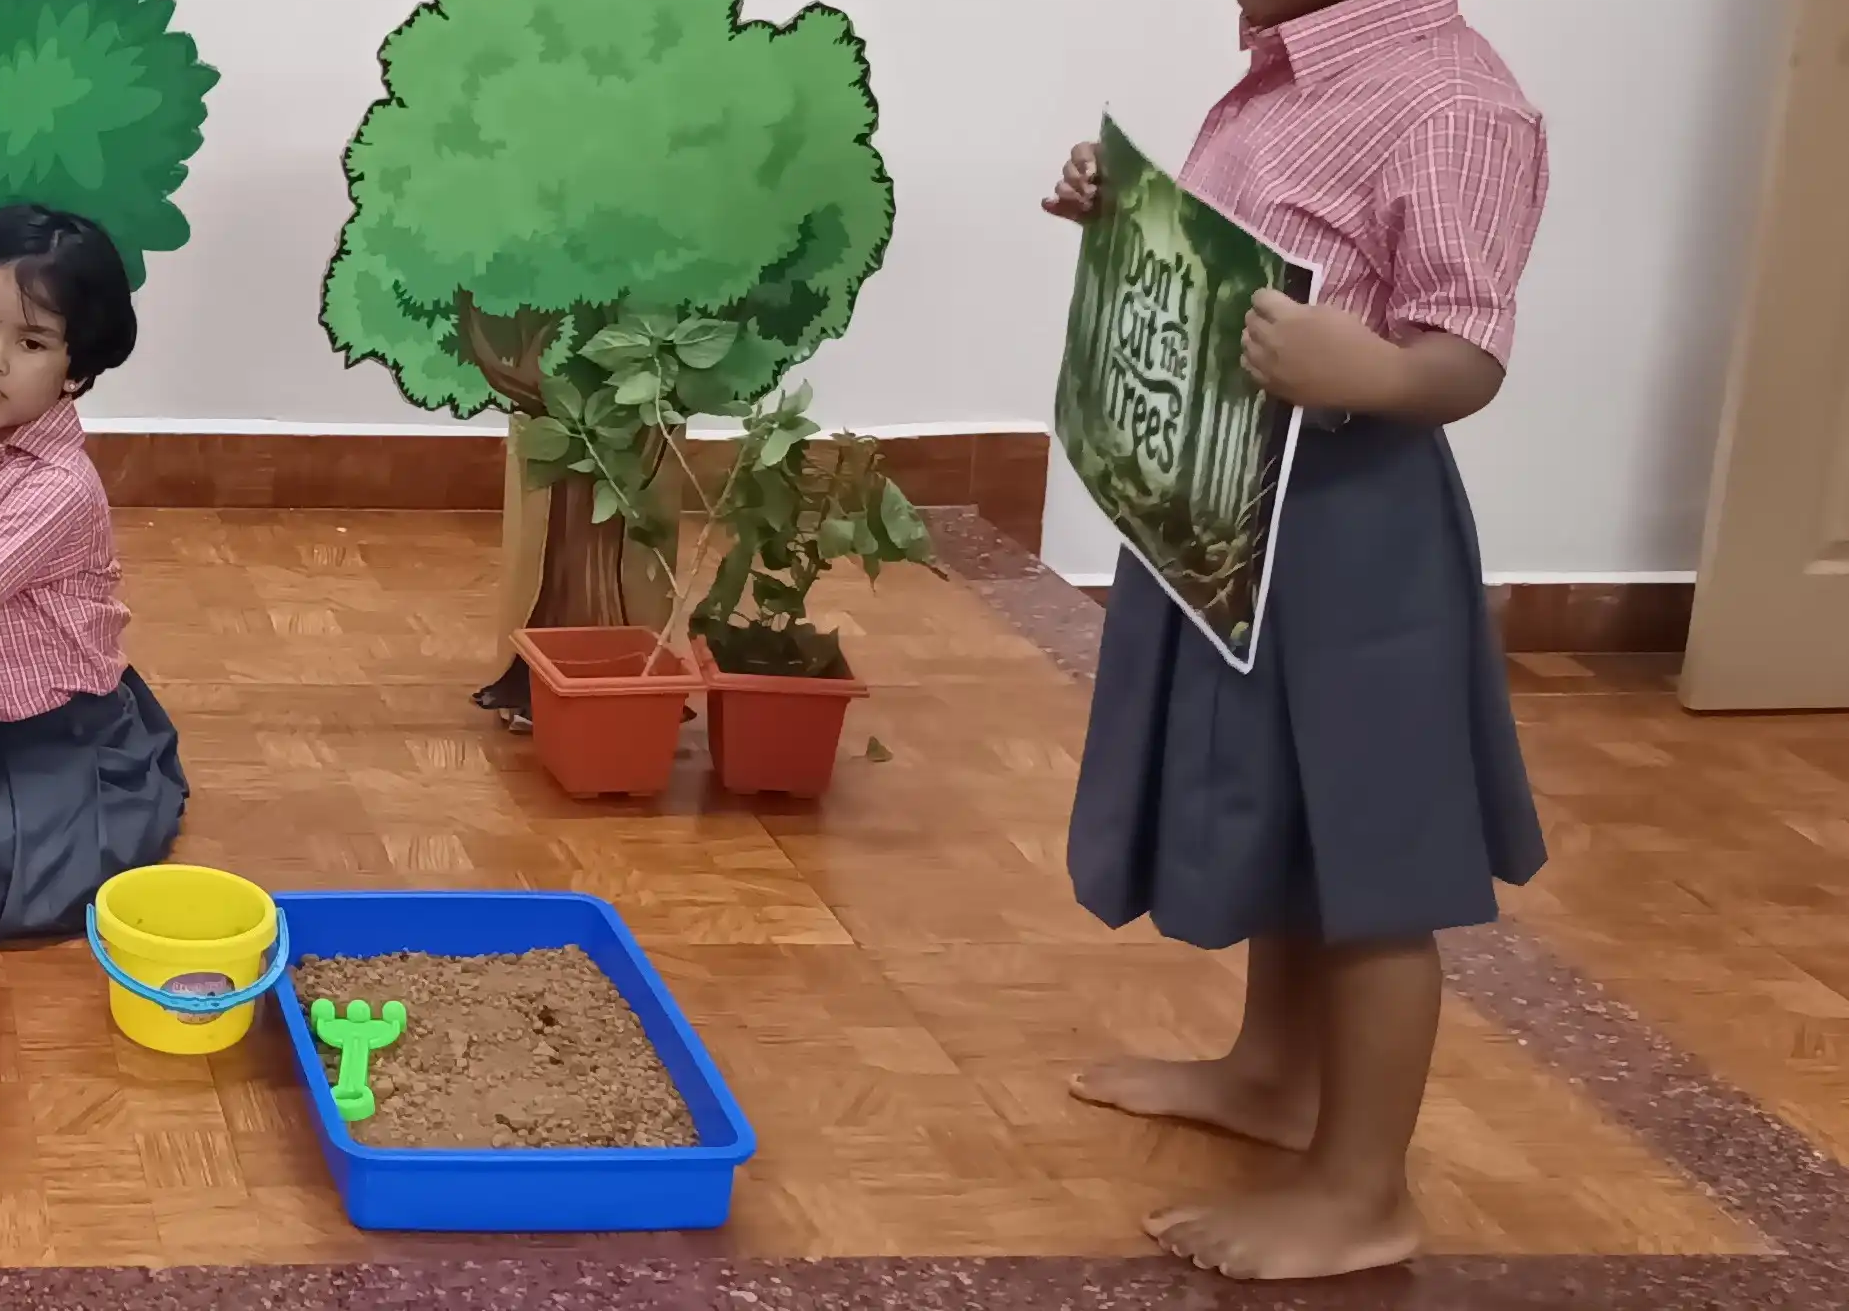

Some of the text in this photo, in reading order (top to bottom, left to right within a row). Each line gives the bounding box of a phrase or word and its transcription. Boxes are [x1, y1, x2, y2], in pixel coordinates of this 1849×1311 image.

[1125, 219, 1194, 324] Don't
[1118, 290, 1157, 370] Cut
[1109, 357, 1177, 474] Trees
